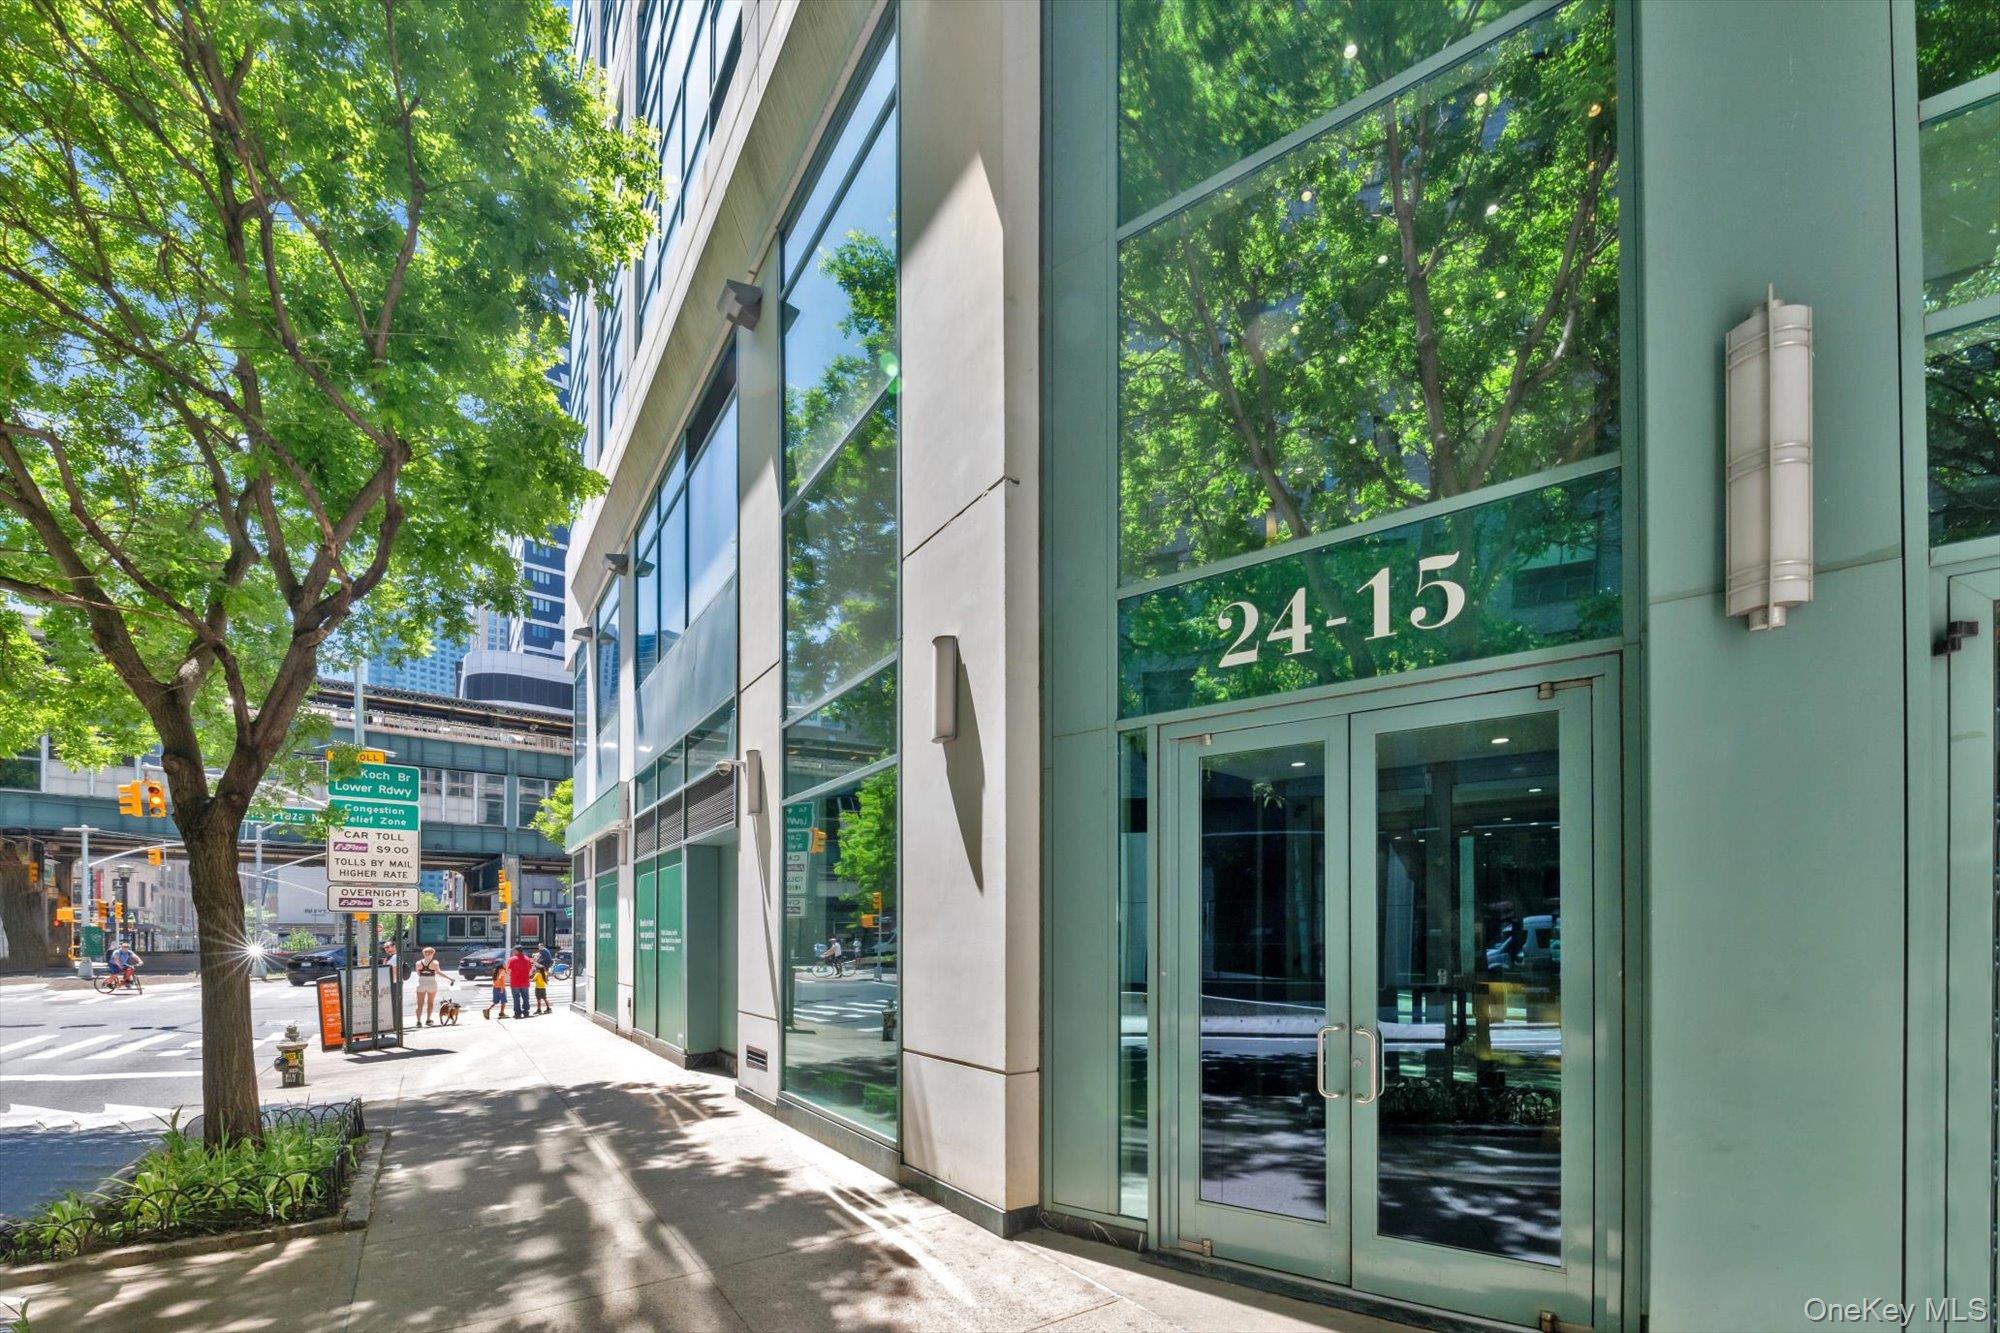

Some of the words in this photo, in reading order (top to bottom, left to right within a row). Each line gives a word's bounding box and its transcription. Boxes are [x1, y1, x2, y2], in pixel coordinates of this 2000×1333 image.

[1217, 551, 1466, 668] 24-15
[361, 769, 390, 780] Koch
[397, 772, 411, 782] Br
[335, 780, 373, 792] Lower
[379, 785, 412, 798] Rdwy
[344, 803, 405, 816] Congestion
[379, 817, 407, 826] Zone
[344, 831, 369, 839] CAR
[375, 832, 405, 841] TOLL
[376, 845, 409, 855] $9.00
[334, 857, 366, 867] TOLLS
[370, 859, 384, 867] BY
[389, 860, 413, 868] MAIL
[339, 869, 377, 878] HIGHER
[383, 870, 408, 879] RATE
[341, 888, 407, 898] OVERNIGHT
[378, 899, 410, 907] $2.25
